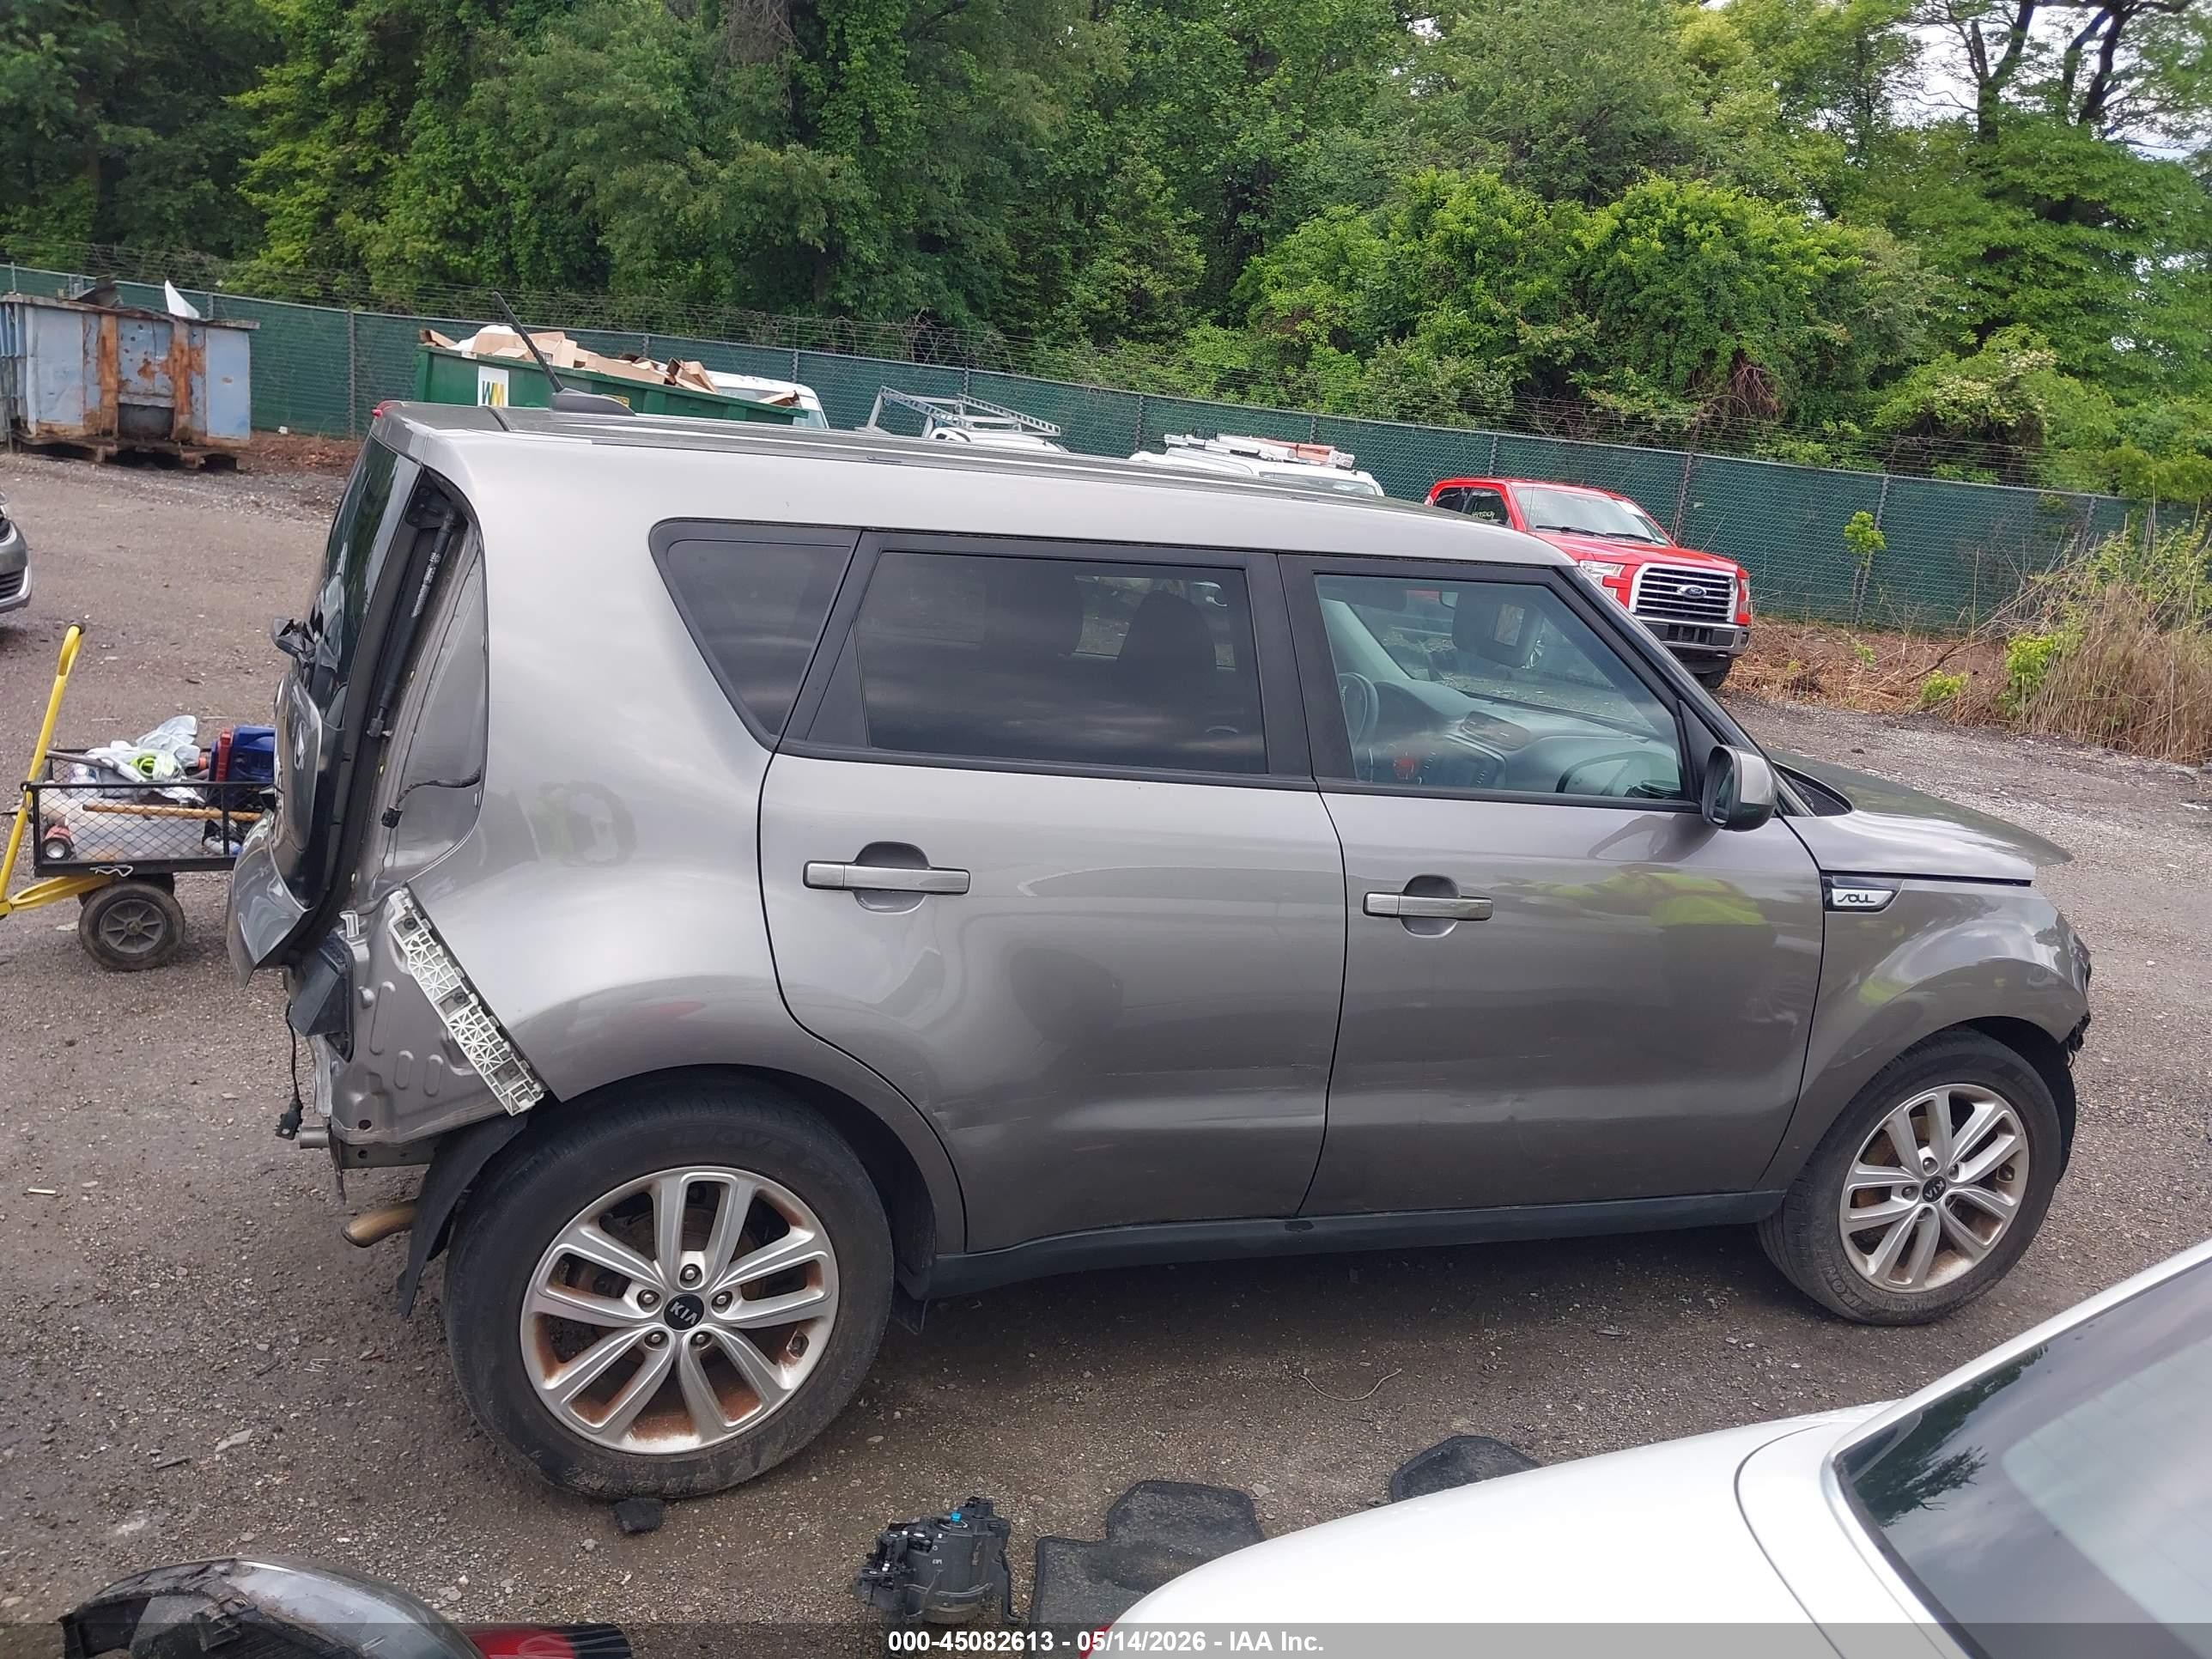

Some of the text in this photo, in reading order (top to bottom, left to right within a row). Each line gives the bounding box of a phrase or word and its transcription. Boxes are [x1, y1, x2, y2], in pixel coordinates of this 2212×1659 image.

[1837, 893, 1875, 903] SOUL
[1925, 1181, 1945, 1199] KIA
[670, 1301, 697, 1325] KIA
